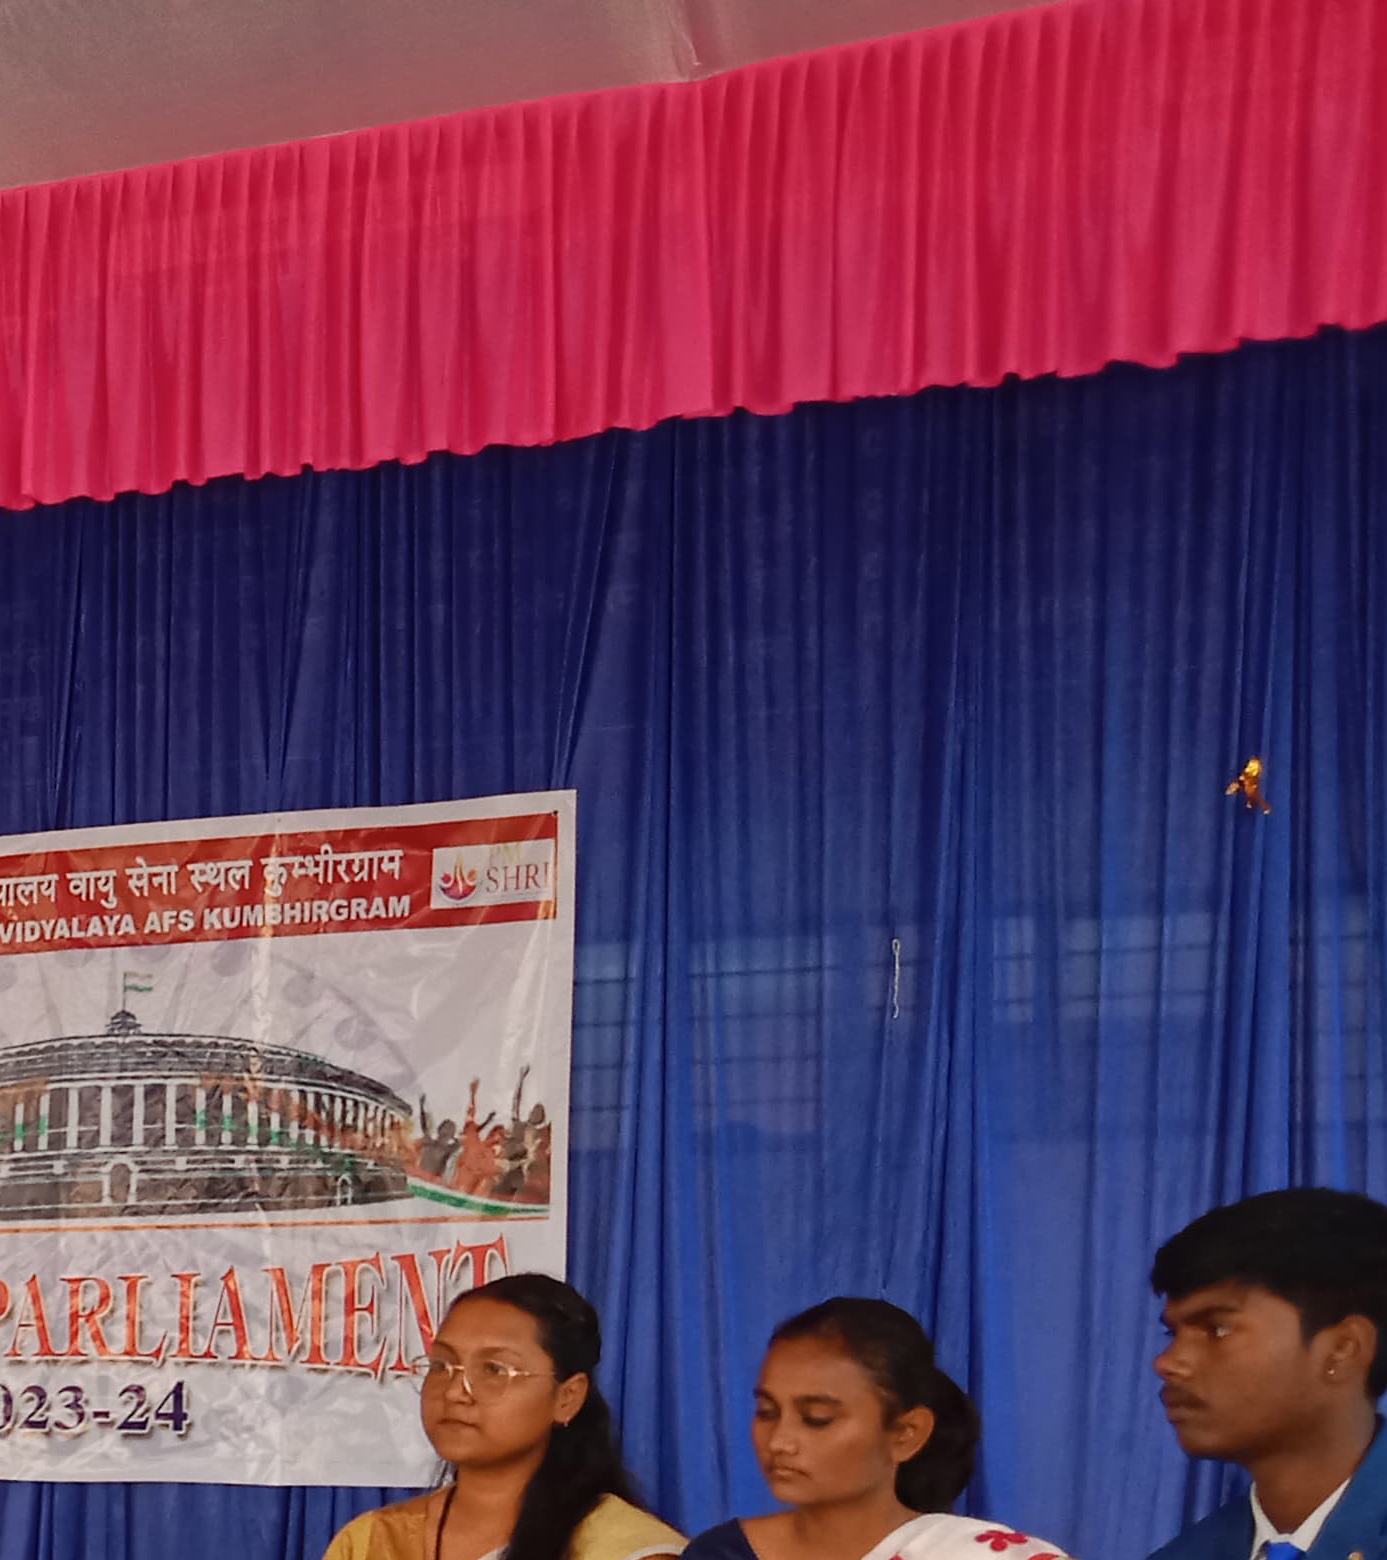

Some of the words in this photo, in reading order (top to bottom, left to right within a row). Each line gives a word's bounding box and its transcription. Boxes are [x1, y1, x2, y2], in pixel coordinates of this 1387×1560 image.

[66, 869, 117, 909] वायु
[125, 857, 178, 897] सेना
[187, 859, 253, 892] स्थल
[261, 843, 404, 898] कुम्भीरग्राम
[486, 861, 549, 893] SHRI
[144, 908, 195, 934] AFS
[203, 895, 411, 931] KUMBHIRGRAM
